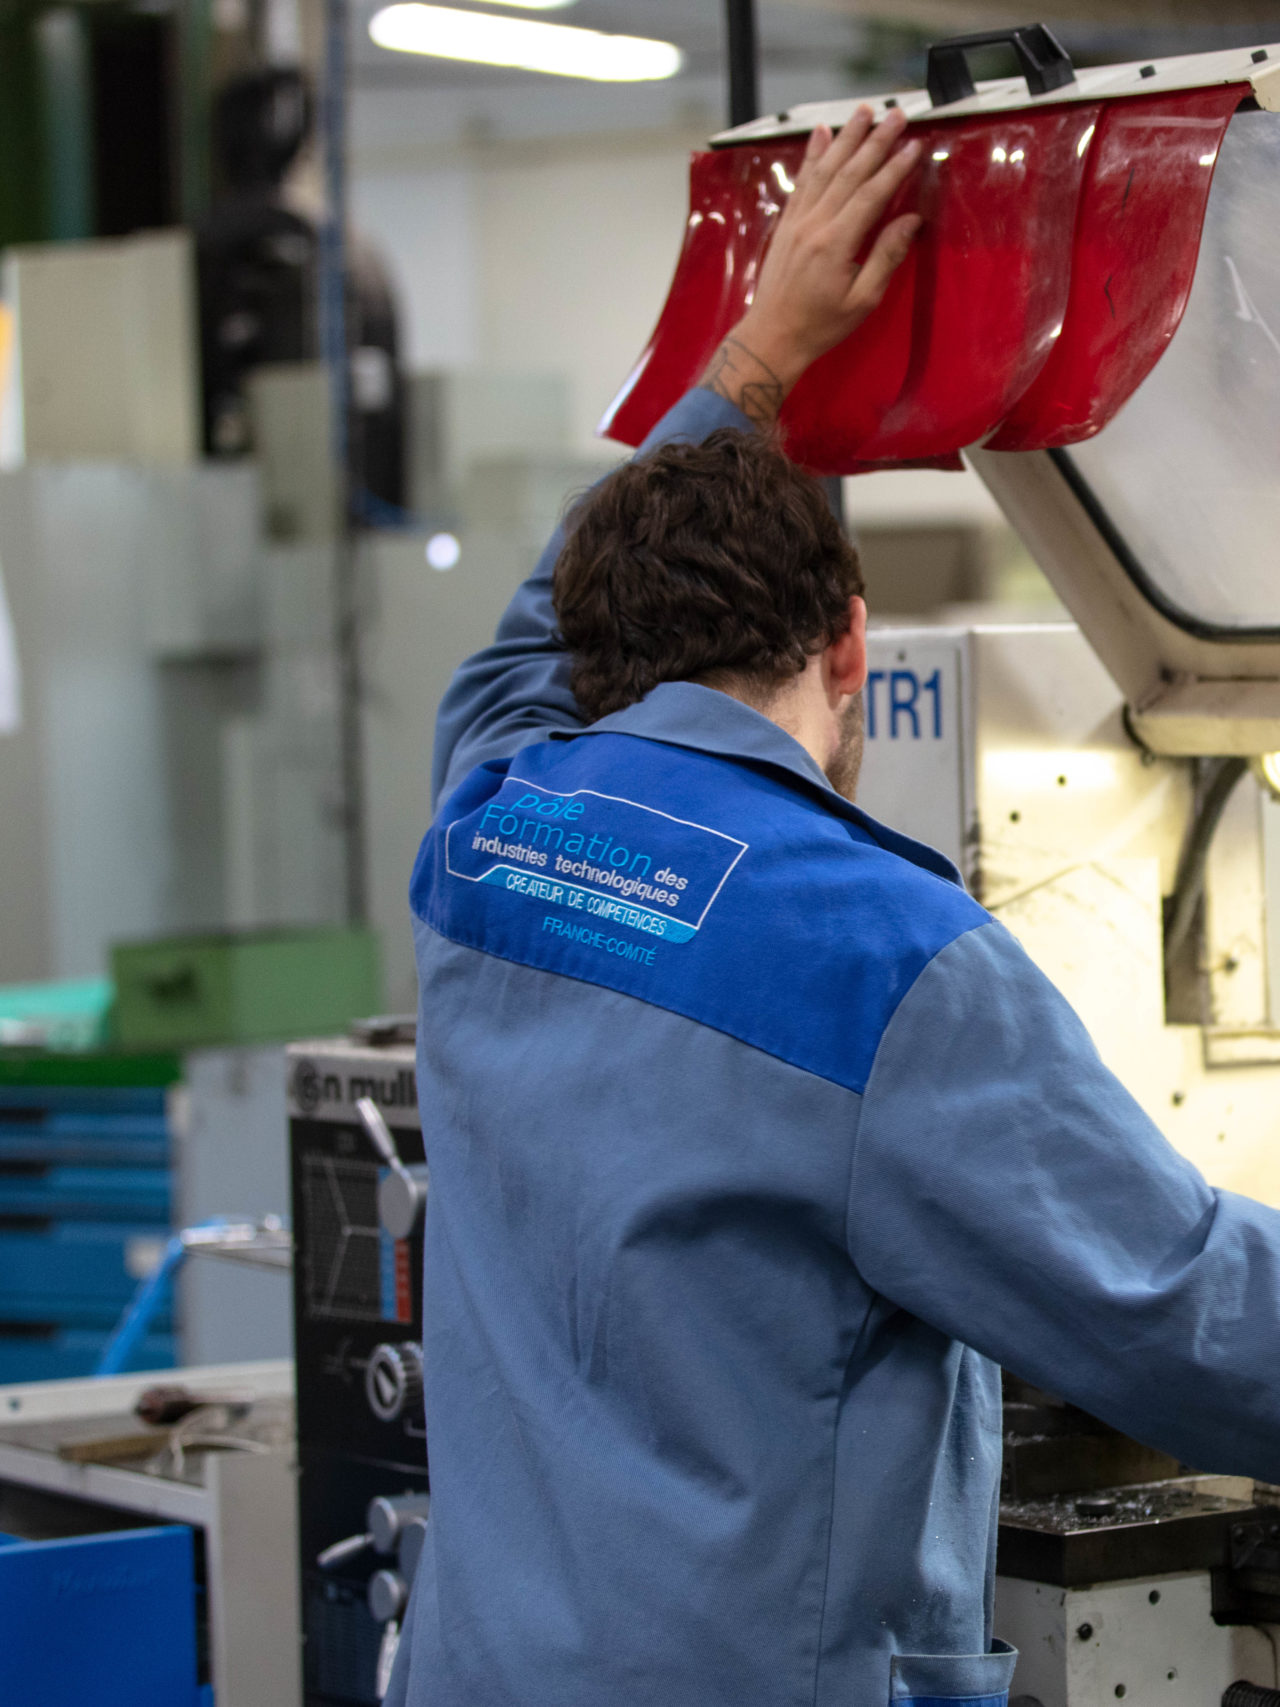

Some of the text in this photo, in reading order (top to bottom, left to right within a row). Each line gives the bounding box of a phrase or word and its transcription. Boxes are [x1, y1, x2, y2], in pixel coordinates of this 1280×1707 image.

[867, 669, 942, 740] TR1
[511, 793, 585, 821] pôle
[472, 831, 680, 907] industries technologiques
[478, 803, 689, 890] Formation des
[505, 873, 668, 936] CREATEUR DE COMPETENCES
[542, 916, 659, 966] FRANCHE-COMTÉ
